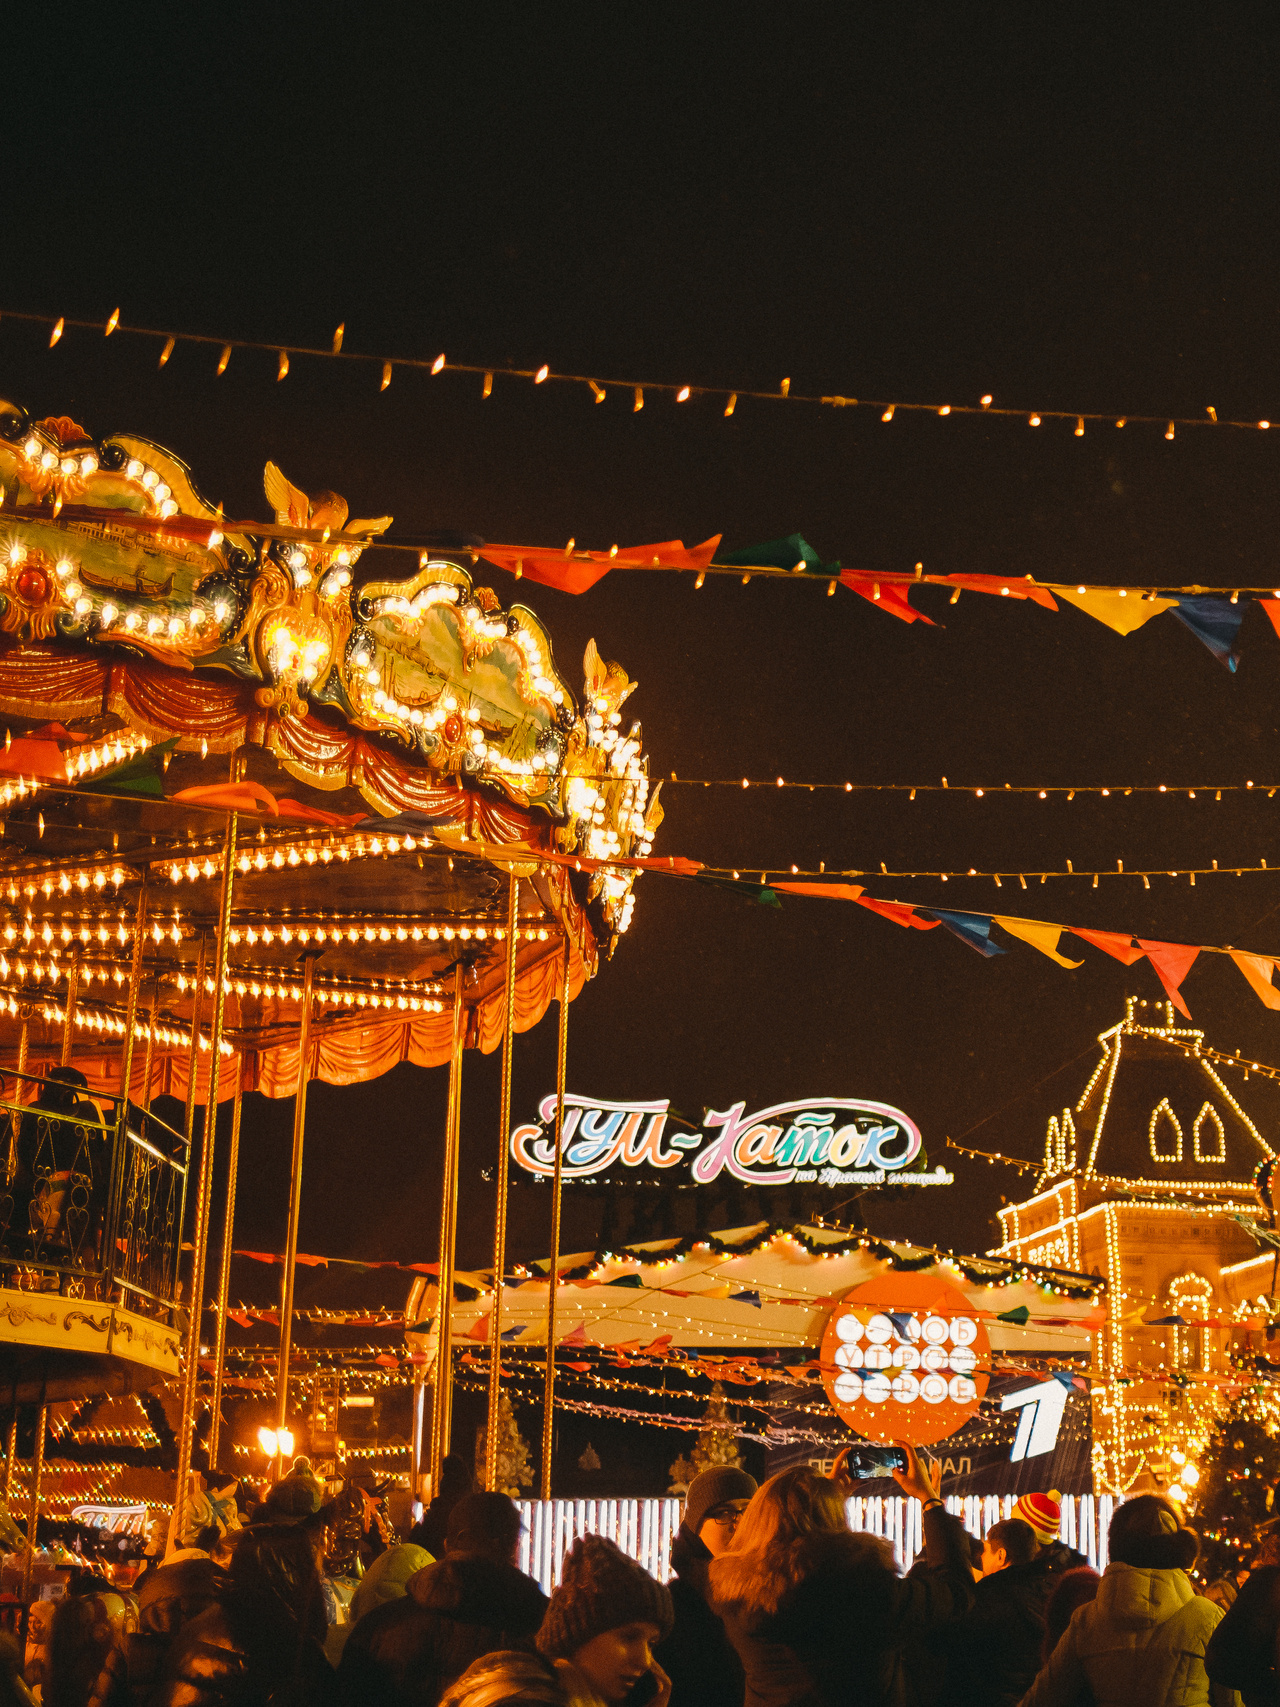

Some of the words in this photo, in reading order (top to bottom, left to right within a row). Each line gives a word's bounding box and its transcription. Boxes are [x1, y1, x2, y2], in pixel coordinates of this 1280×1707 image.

[795, 1170, 818, 1182] на
[818, 1167, 885, 1188] Красной
[887, 1165, 954, 1188] площади
[842, 1348, 945, 1370] УТРО
[901, 1379, 968, 1399] РОЕ
